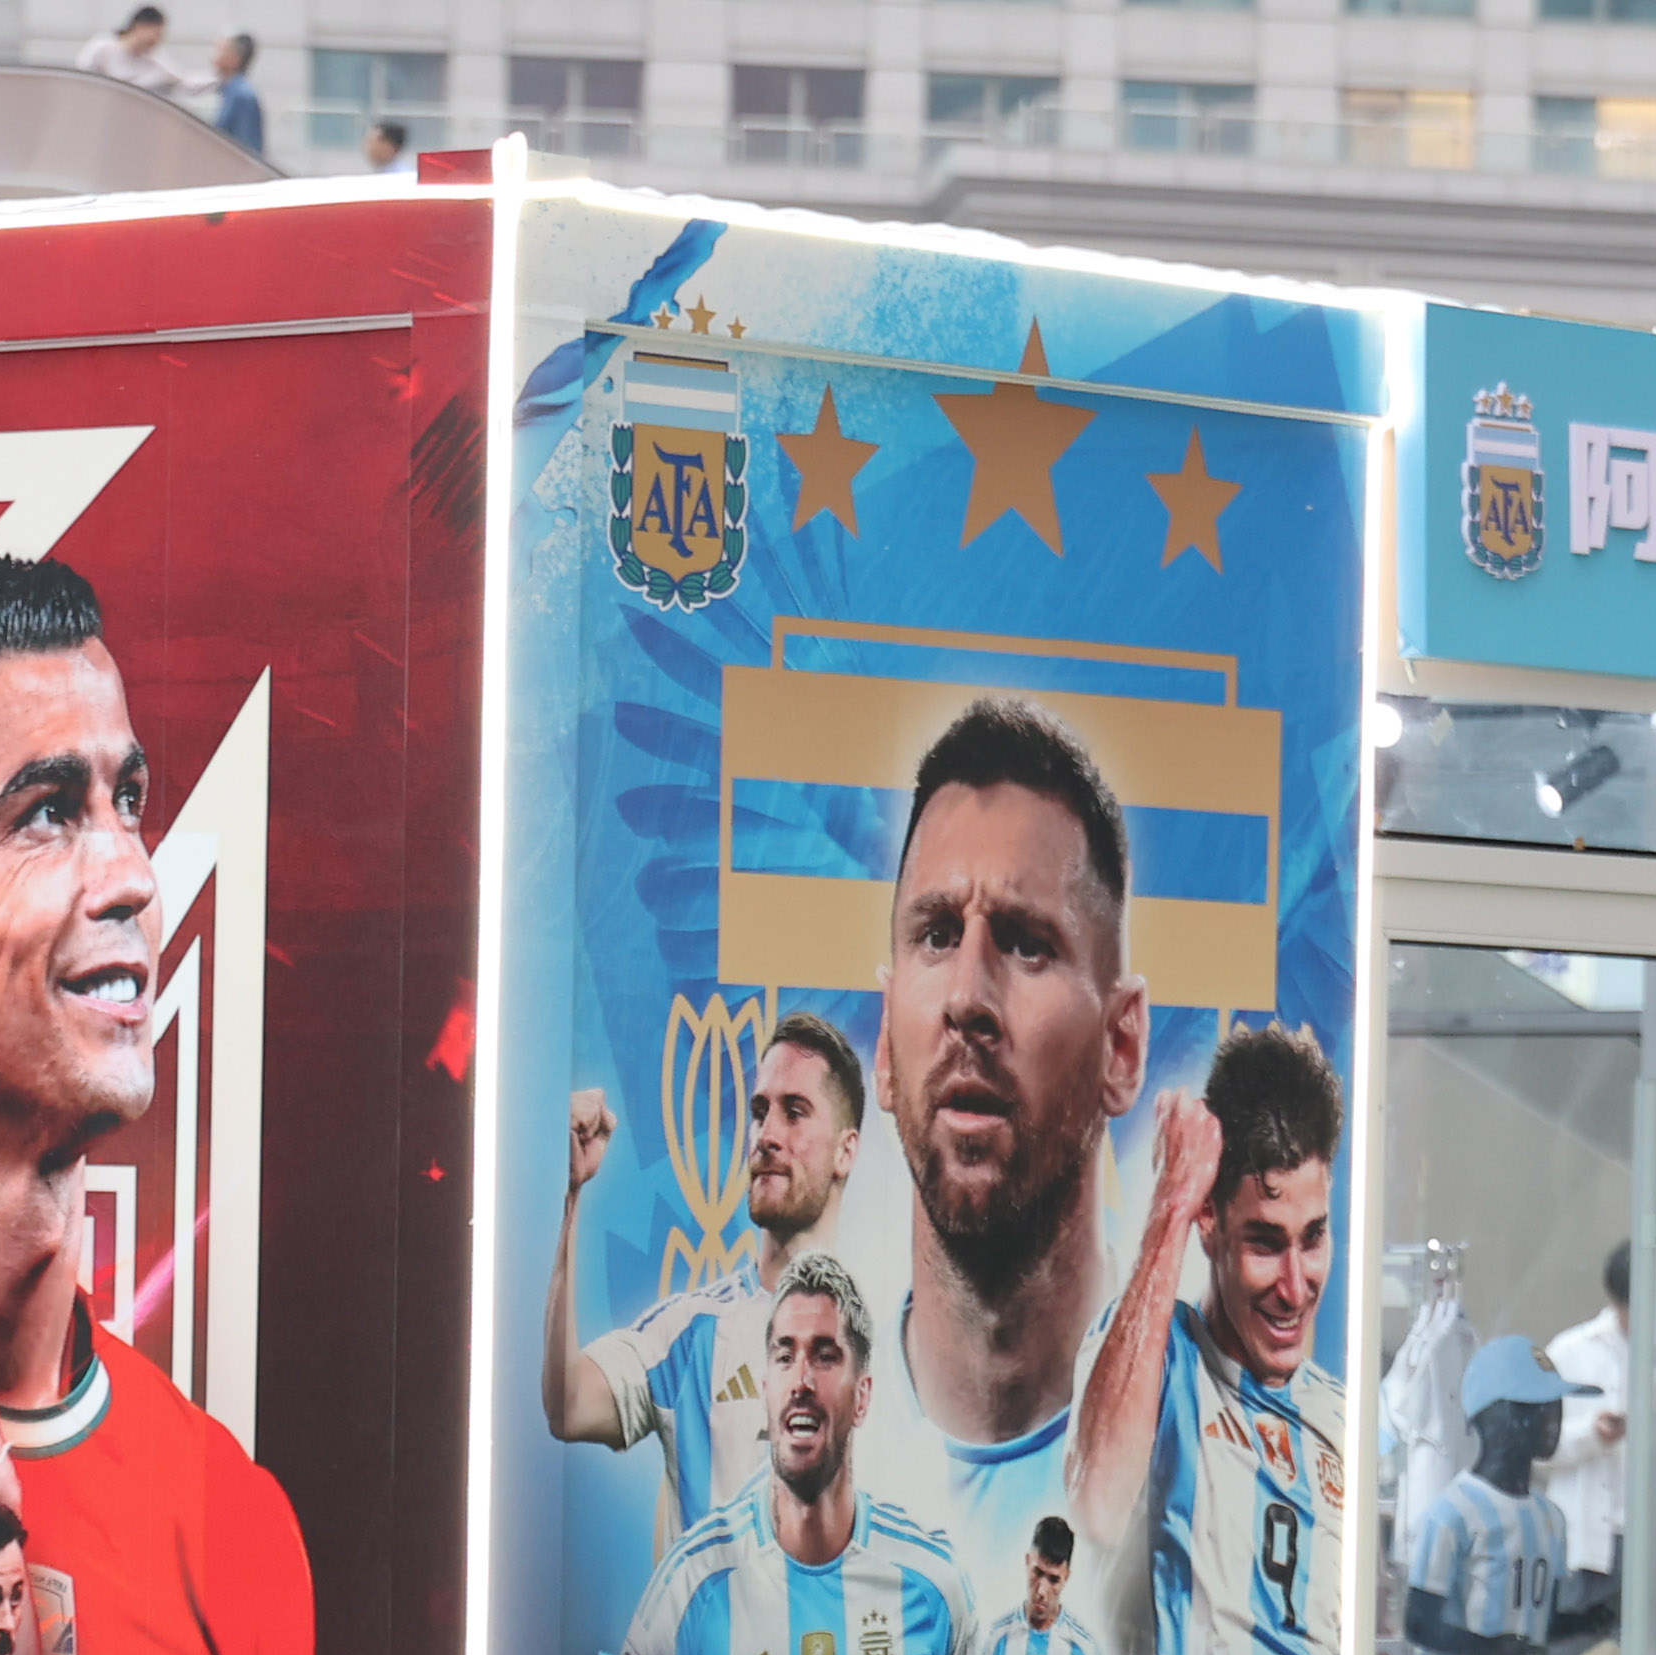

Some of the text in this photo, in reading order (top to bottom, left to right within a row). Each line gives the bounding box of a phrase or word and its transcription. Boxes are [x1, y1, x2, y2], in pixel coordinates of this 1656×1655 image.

[635, 440, 720, 557] AFA
[1484, 474, 1529, 546] AFA
[1262, 1503, 1298, 1628] 9
[1511, 1556, 1549, 1611] 10
